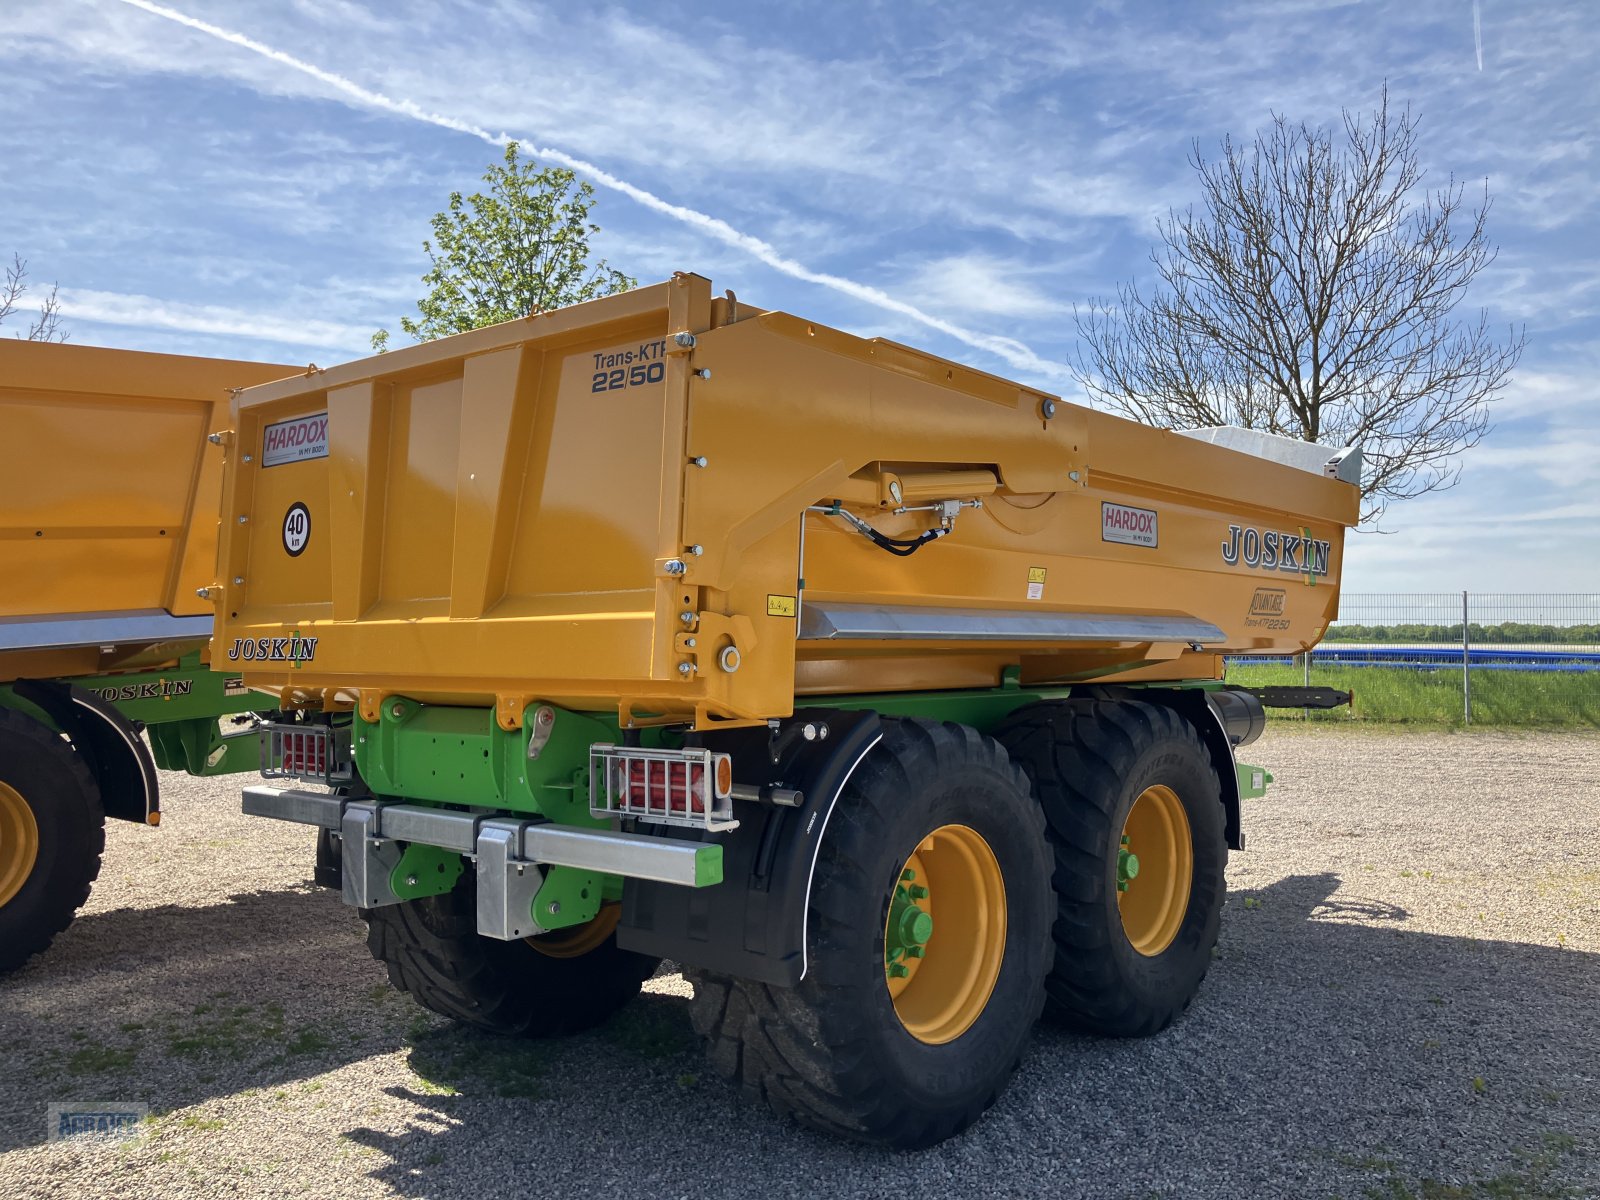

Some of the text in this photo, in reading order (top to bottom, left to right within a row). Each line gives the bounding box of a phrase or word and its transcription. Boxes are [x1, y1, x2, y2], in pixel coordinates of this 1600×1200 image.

[591, 362, 665, 394] 22/50
[266, 418, 329, 452] HARDOX
[304, 447, 312, 455] MY
[312, 445, 325, 454] BODY
[288, 512, 304, 535] 40
[1105, 507, 1154, 534] HARDOX
[291, 536, 300, 547] km
[1221, 524, 1331, 577] JOSKIN
[228, 637, 318, 662] JOSKIN
[88, 679, 193, 702] OSKIN
